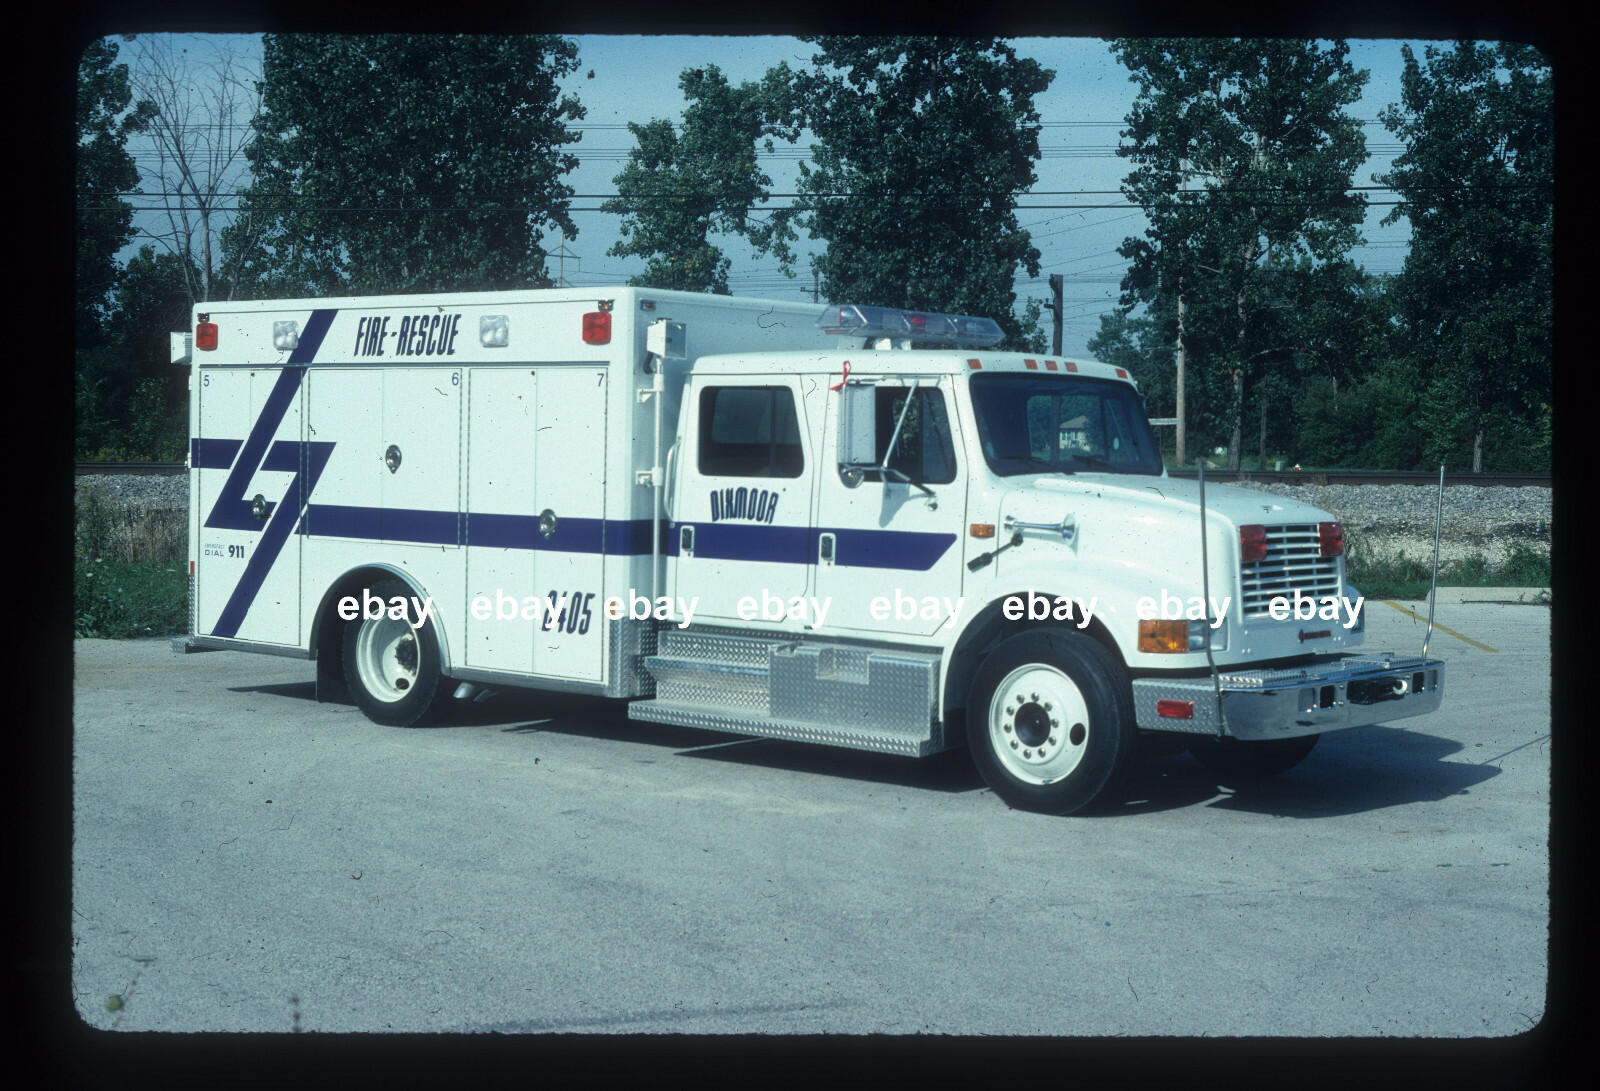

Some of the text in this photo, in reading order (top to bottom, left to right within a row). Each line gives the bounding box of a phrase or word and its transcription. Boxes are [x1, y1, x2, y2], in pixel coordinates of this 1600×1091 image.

[203, 374, 210, 387] 5
[451, 373, 459, 386] 6
[597, 373, 605, 387] 7
[710, 486, 779, 524] DIXMOOR
[204, 549, 224, 557] DIAL
[228, 544, 245, 559] 911
